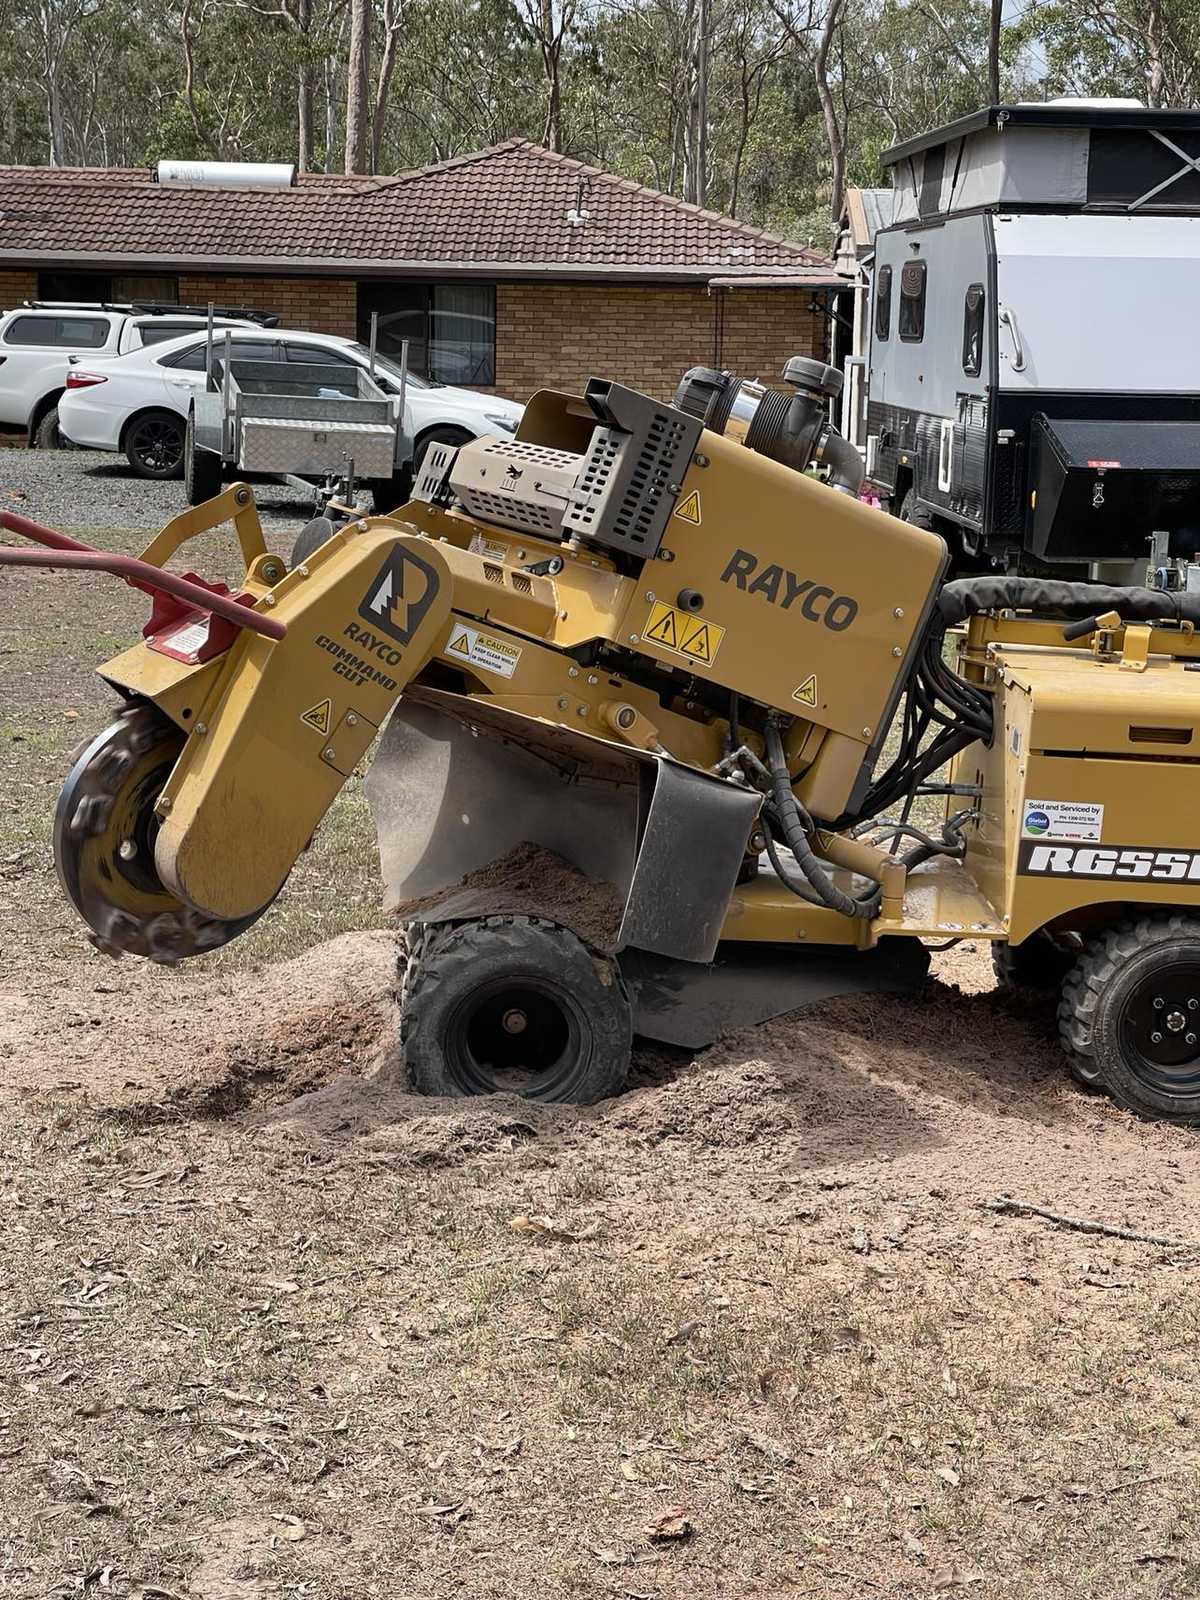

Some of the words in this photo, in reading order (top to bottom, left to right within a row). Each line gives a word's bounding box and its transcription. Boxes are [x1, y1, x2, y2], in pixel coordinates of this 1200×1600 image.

[719, 548, 859, 632] RAYCO
[343, 621, 402, 667] RAYCO
[485, 639, 519, 657] CAUTION
[314, 634, 399, 692] COMMAND
[477, 657, 502, 669] OPERATION
[486, 651, 501, 660] CLEAR
[332, 661, 369, 687] CUT
[1028, 802, 1045, 810] Sold
[1060, 804, 1091, 813] Serviced
[1091, 806, 1100, 815] by
